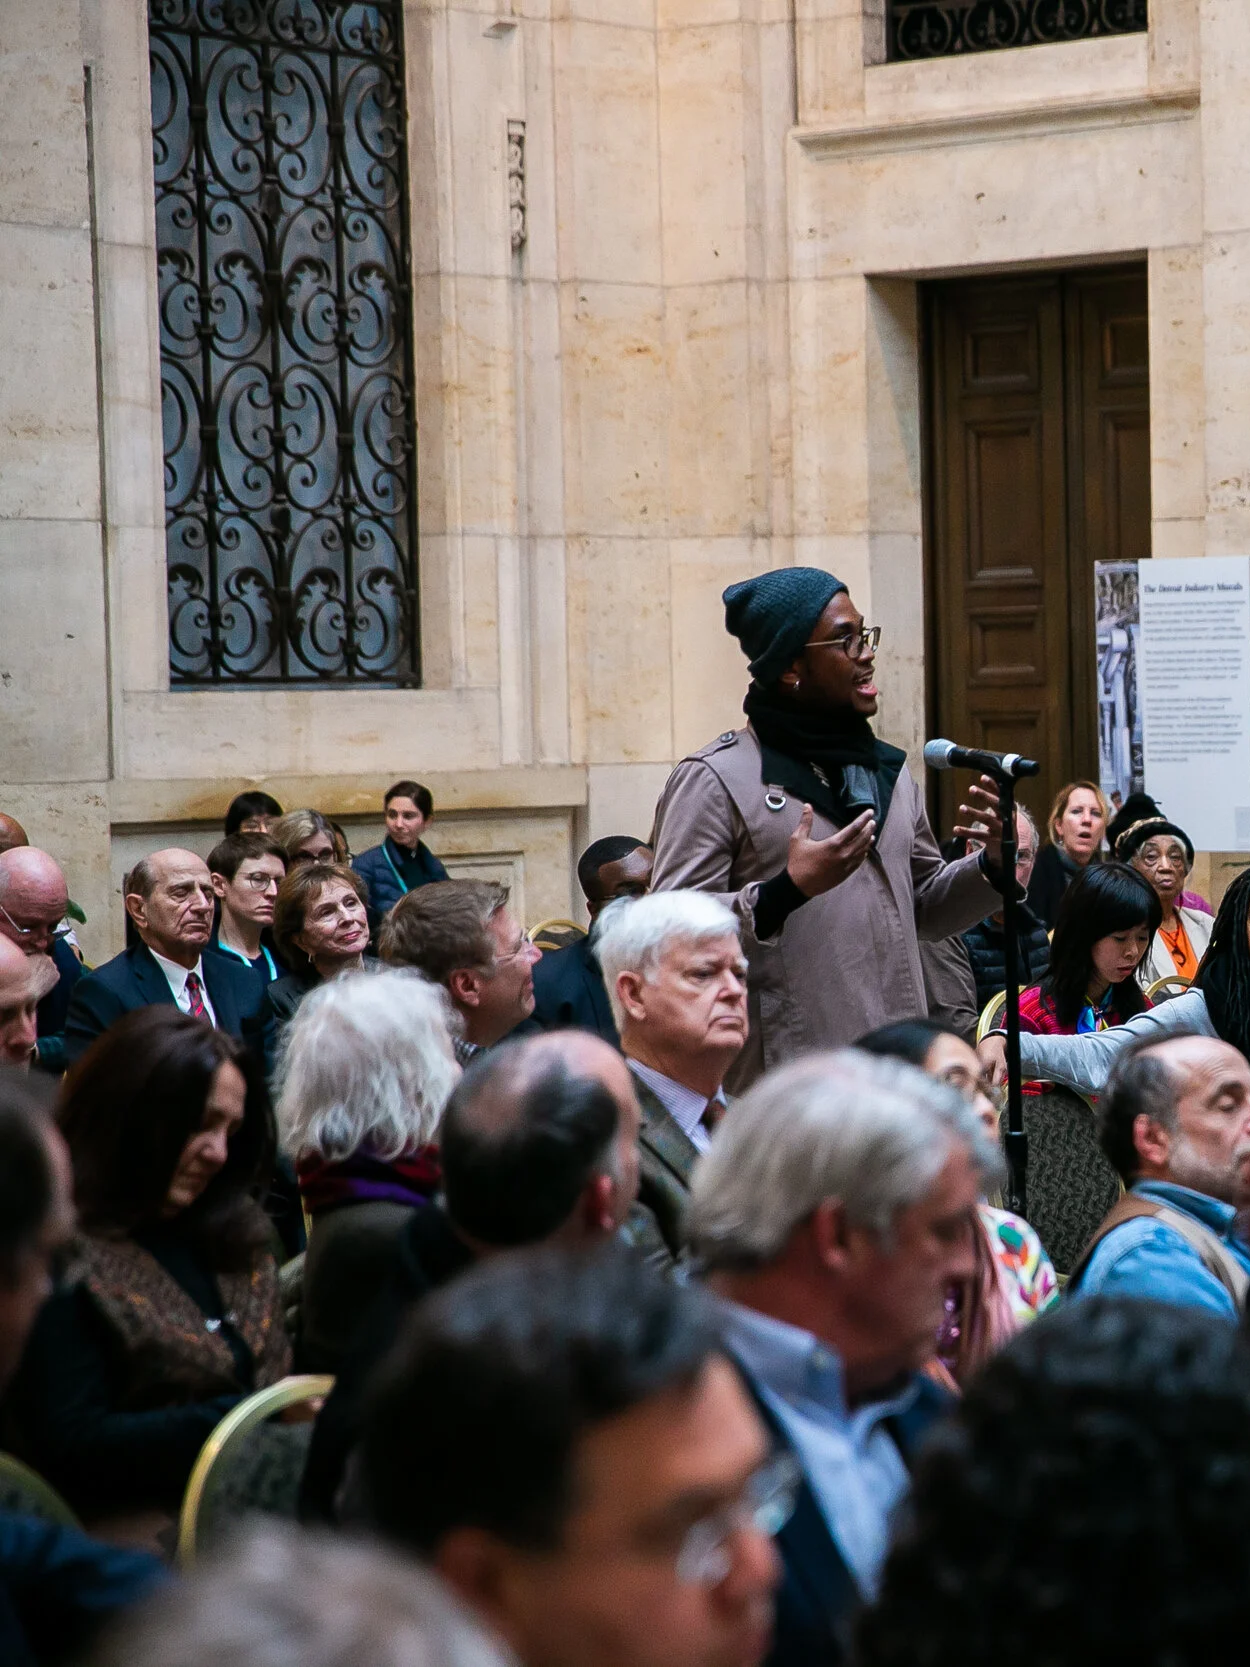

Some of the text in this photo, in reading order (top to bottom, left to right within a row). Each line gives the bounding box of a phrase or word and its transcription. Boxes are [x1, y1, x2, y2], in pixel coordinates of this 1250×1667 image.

[1144, 583, 1156, 593] The
[1158, 582, 1182, 592] Detroit
[1185, 581, 1214, 592] Industry
